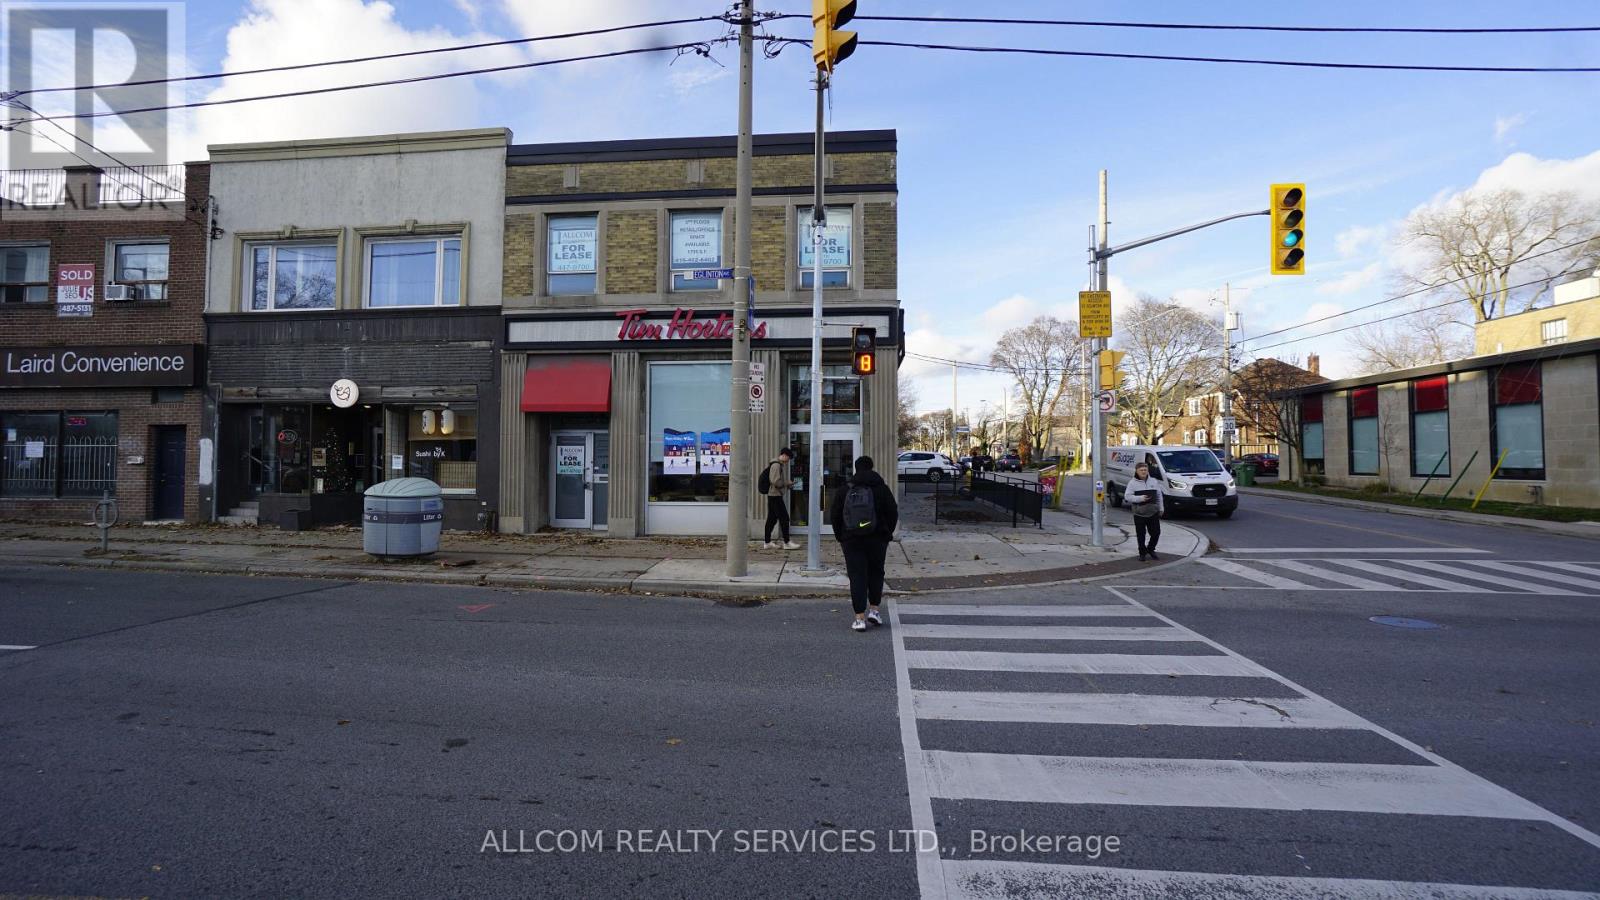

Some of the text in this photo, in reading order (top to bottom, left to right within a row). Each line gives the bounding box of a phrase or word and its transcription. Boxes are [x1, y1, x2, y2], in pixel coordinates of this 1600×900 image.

[561, 244, 586, 252] FOR
[554, 251, 593, 260] LEASE
[60, 270, 93, 280] SOLD
[694, 270, 723, 279] EGLINTON
[615, 308, 664, 341] Tim
[7, 351, 184, 373] Laird Convenience
[860, 354, 871, 371] 8
[1225, 422, 1233, 430] 30
